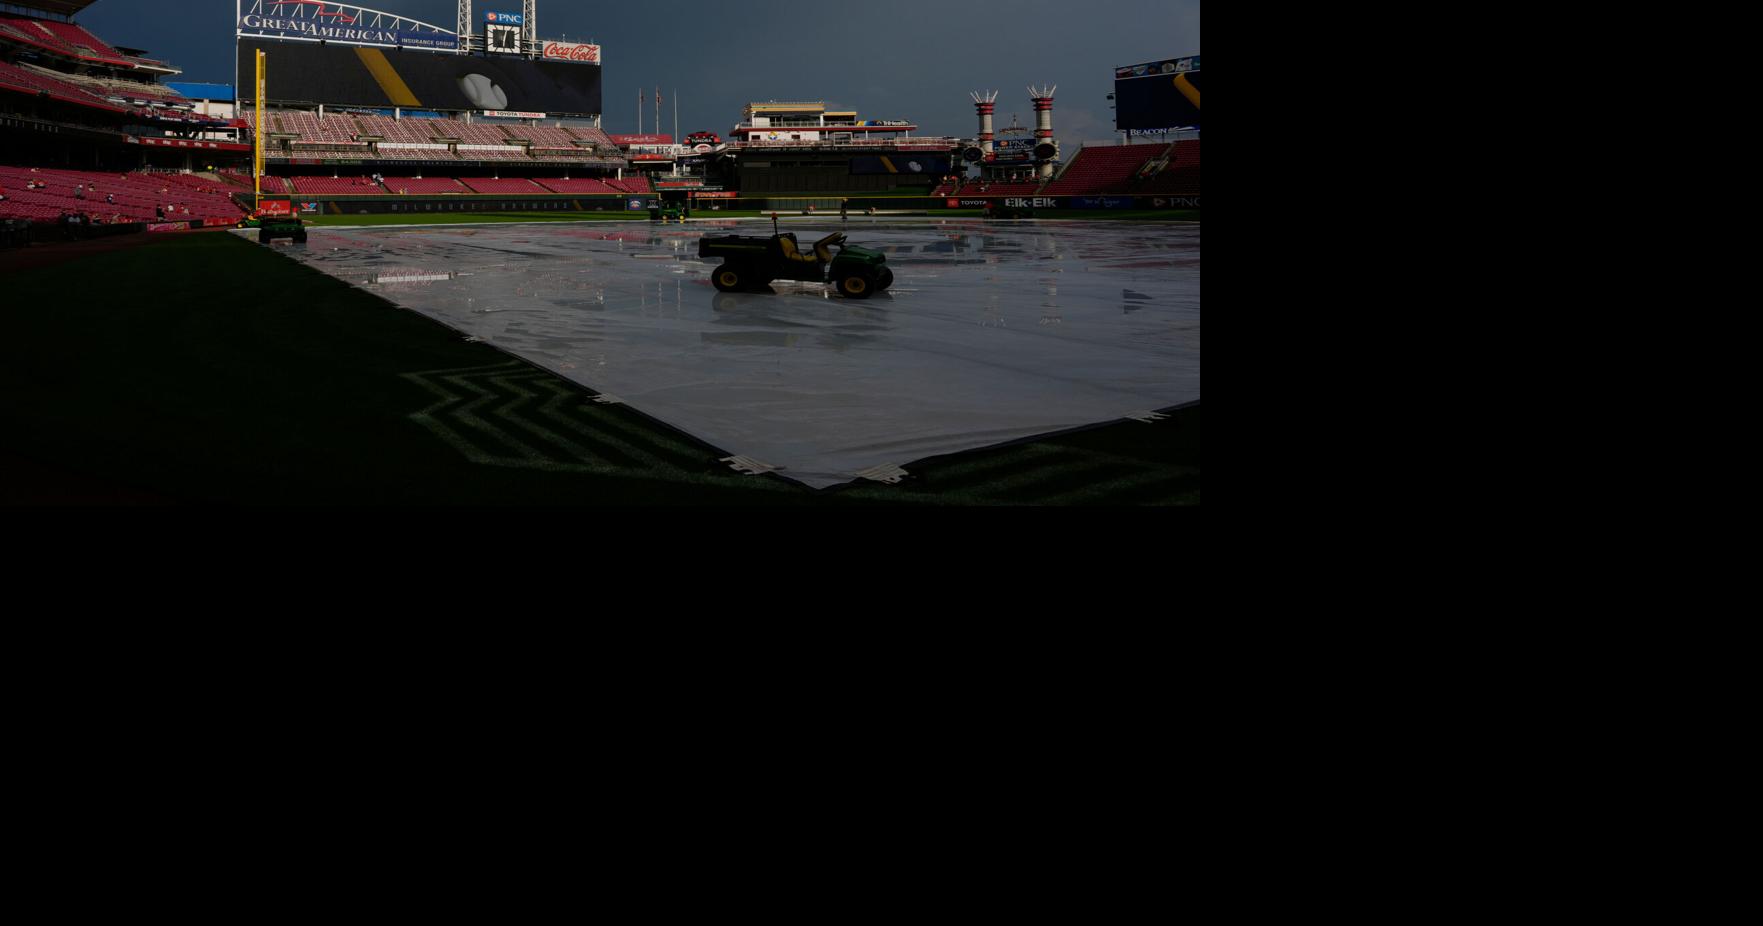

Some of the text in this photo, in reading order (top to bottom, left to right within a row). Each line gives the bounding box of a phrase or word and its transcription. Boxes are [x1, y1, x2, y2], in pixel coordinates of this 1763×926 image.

[499, 13, 522, 23] PNC
[243, 14, 396, 42] GREAT AMERICAN
[401, 37, 434, 46] INSURANCE
[543, 42, 598, 61] Coca-Cola
[1129, 128, 1168, 136] BEACON
